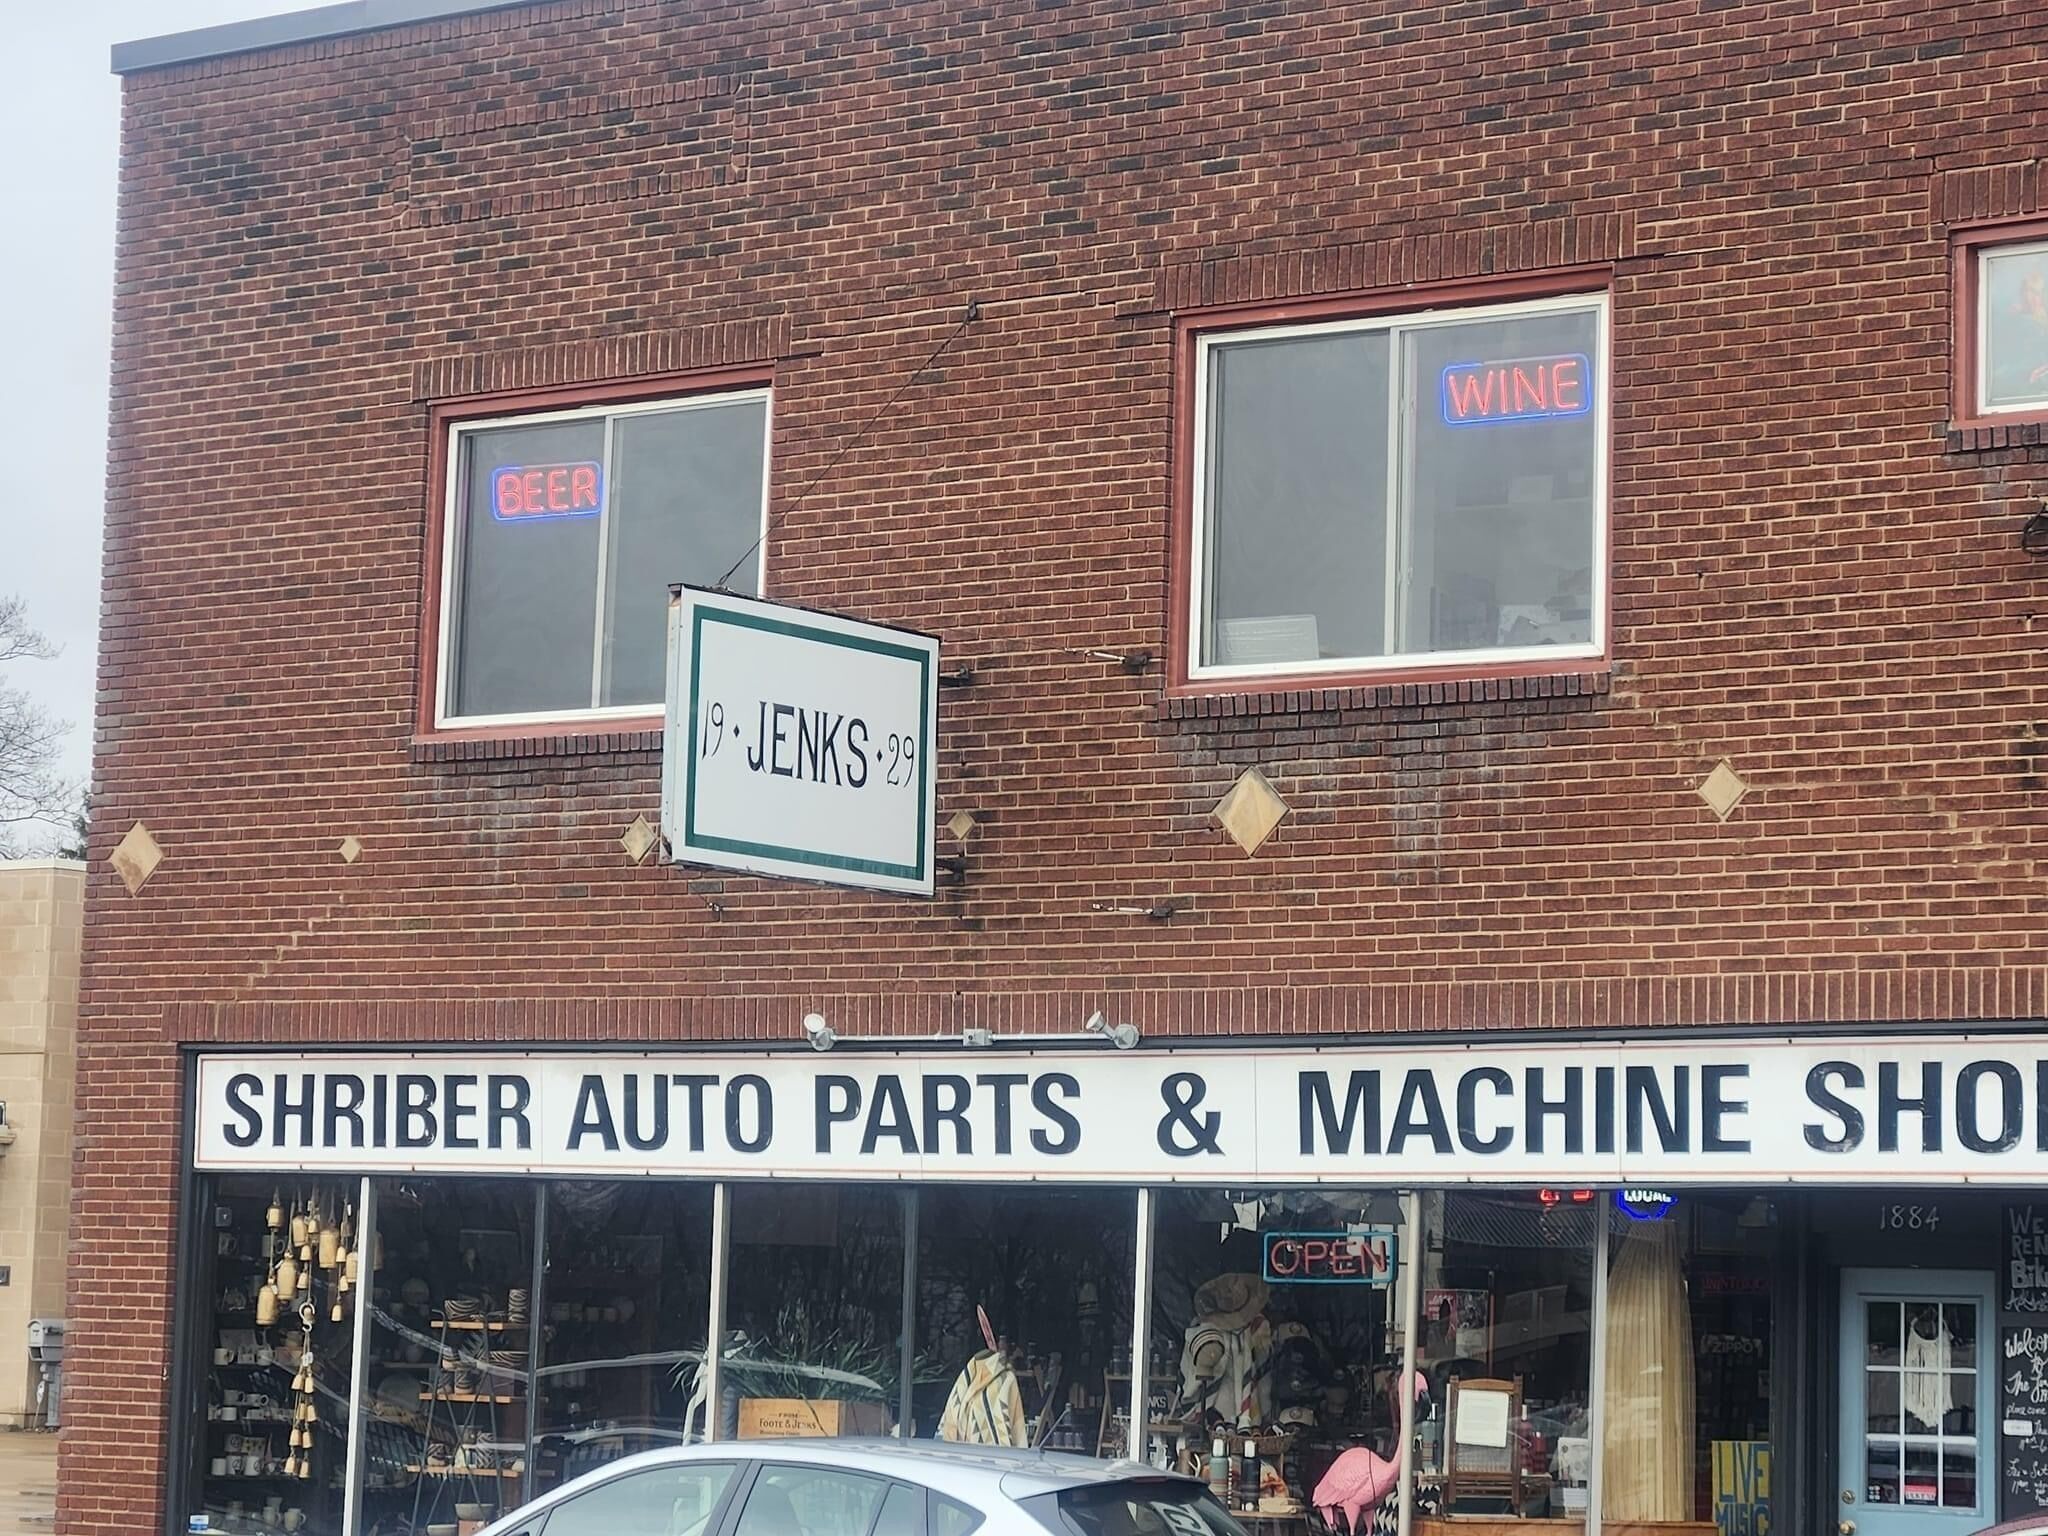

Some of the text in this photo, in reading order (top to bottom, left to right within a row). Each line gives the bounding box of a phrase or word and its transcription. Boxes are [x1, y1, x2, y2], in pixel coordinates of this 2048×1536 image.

[1449, 361, 1579, 416] WINE
[498, 466, 599, 515] BEER
[701, 700, 915, 789] 19 JENKS 29
[223, 1059, 2048, 1156] SHRIBER AUTO PARTS & MACHINE SHO
[1880, 1204, 1940, 1232] 1884
[1271, 1240, 1386, 1275] OPEN
[1712, 1342, 1753, 1353] ZIPPO
[2004, 1370, 2030, 1397] The
[1717, 1441, 1769, 1505] LIVE
